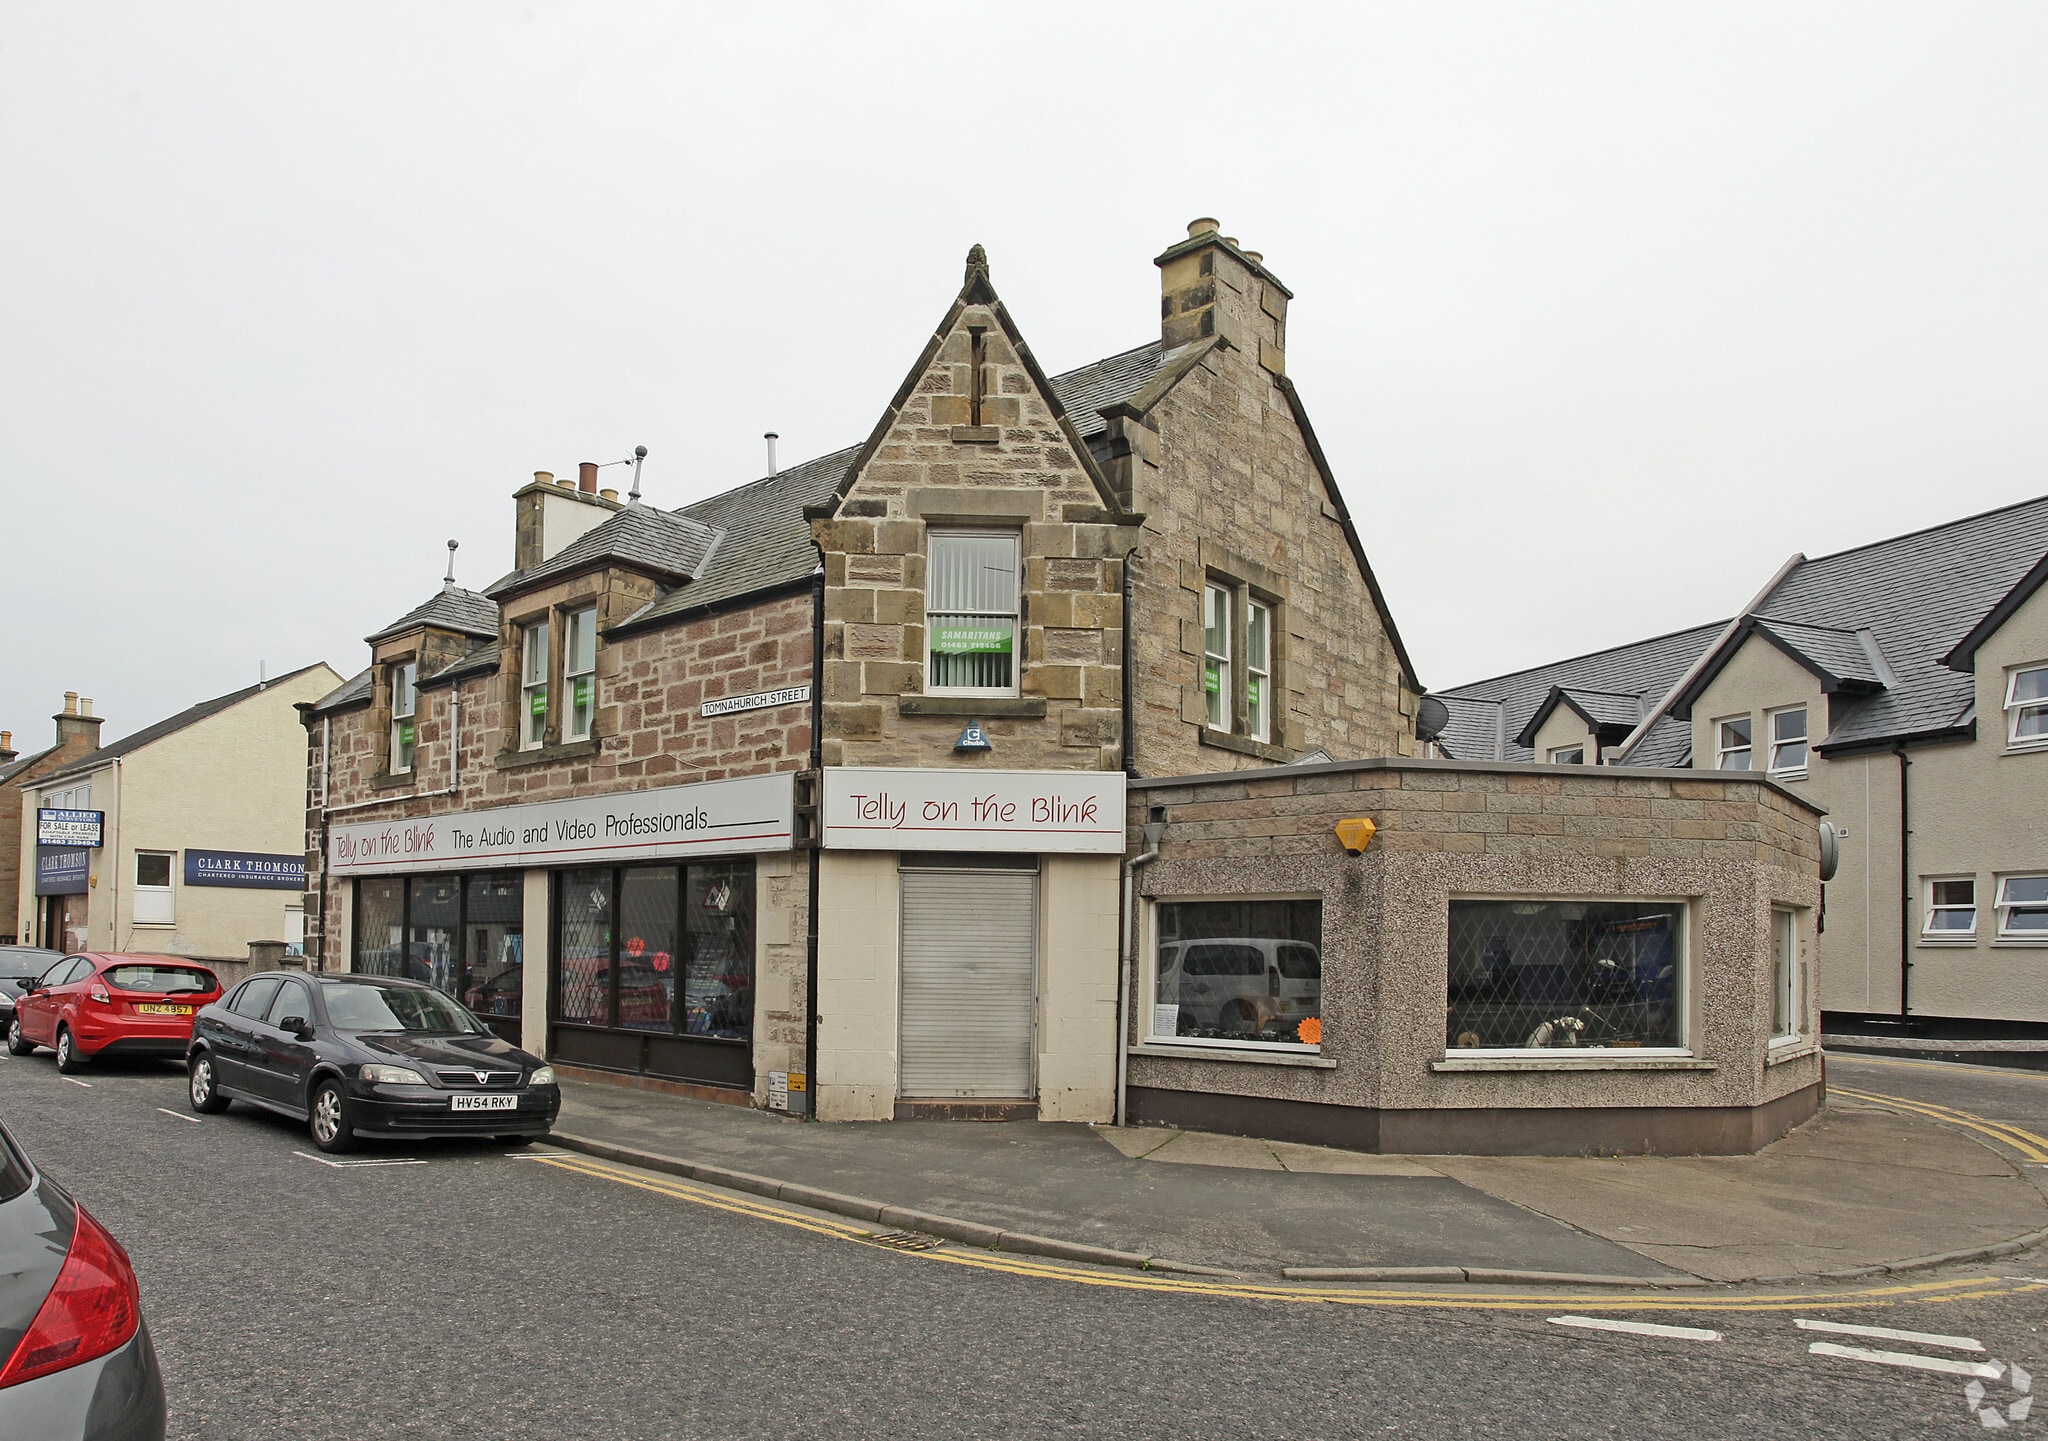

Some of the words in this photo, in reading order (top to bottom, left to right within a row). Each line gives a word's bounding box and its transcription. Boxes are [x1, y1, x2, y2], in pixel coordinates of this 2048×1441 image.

[941, 631, 1002, 640] SAMARITANS
[704, 695, 767, 715] TOMNAHURICH
[770, 688, 806, 704] STREET
[58, 811, 97, 819] ALLIED
[850, 792, 906, 829] Telly
[923, 801, 958, 822] on
[971, 794, 1017, 822] the
[1032, 795, 1098, 824] Blink
[40, 821, 52, 830] FOR
[53, 822, 69, 831] SALE
[80, 823, 99, 832] LEASE
[452, 829, 473, 849] The
[479, 826, 515, 847] Audio
[523, 821, 548, 844] and
[555, 818, 596, 841] Video
[605, 806, 708, 837] Professionals
[336, 833, 357, 866] Telly
[361, 837, 377, 857] on
[380, 828, 400, 855] the
[404, 823, 435, 853] Blink
[41, 855, 58, 870] CLARK
[60, 852, 86, 869] THOMSON
[198, 858, 241, 871] CLARK
[246, 860, 305, 874] THOMSON
[143, 1005, 162, 1013] UNZ
[165, 1005, 188, 1013] 4857
[457, 1097, 488, 1109] HV54
[491, 1097, 513, 1107] RKY
